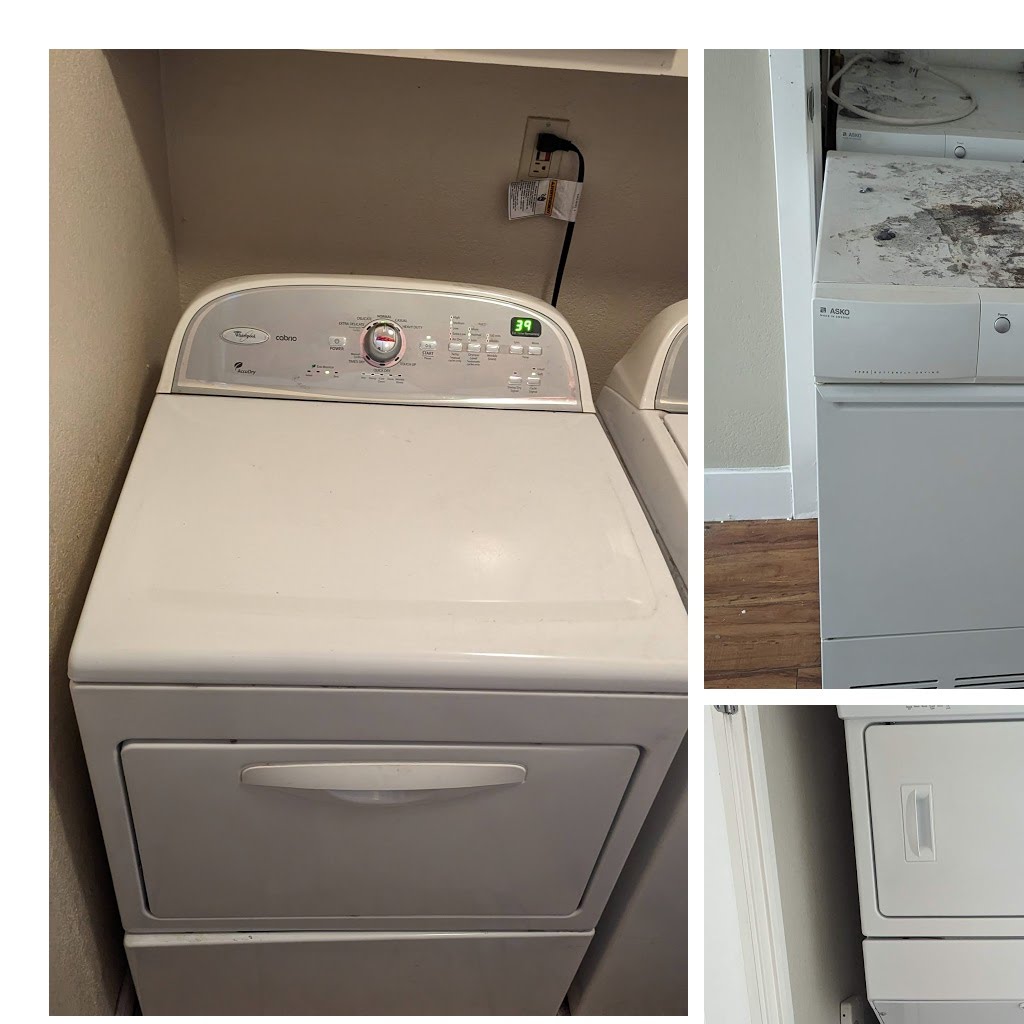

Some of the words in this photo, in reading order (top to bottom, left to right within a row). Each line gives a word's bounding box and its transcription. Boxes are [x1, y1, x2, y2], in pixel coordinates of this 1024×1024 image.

[829, 307, 851, 316] ASKO
[515, 319, 532, 332] 39
[237, 368, 257, 376] AccuDry
